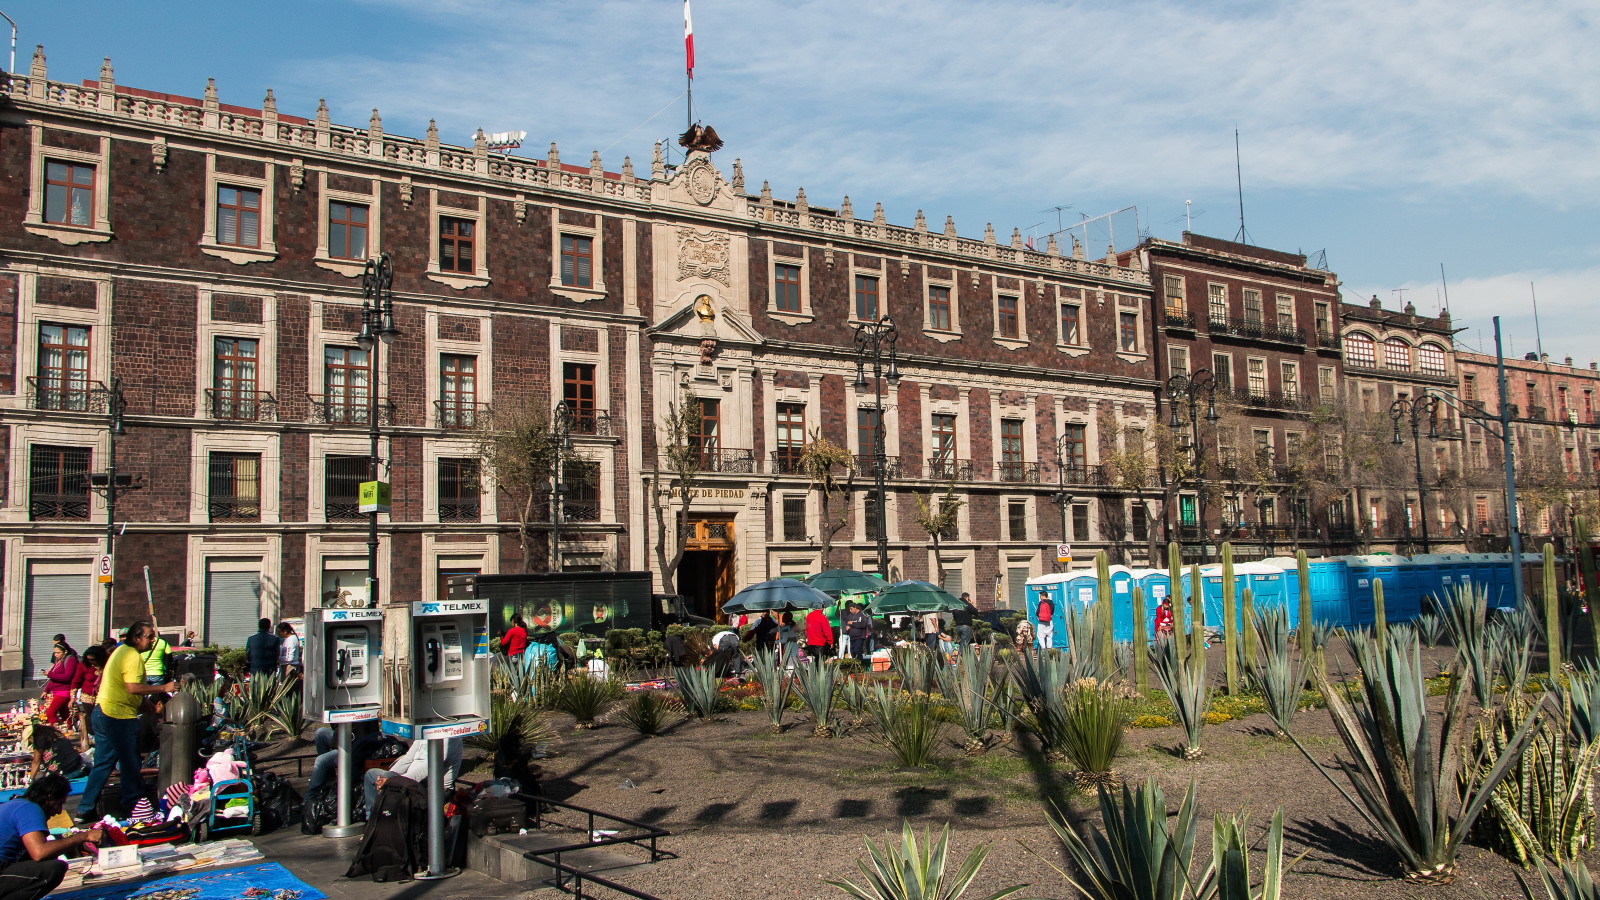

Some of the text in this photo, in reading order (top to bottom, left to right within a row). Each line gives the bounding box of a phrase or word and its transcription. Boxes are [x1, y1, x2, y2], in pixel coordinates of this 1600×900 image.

[701, 488, 713, 498] DE
[715, 489, 744, 498] PIEDAD
[442, 602, 482, 611] TELMEX
[453, 726, 471, 735] celular
